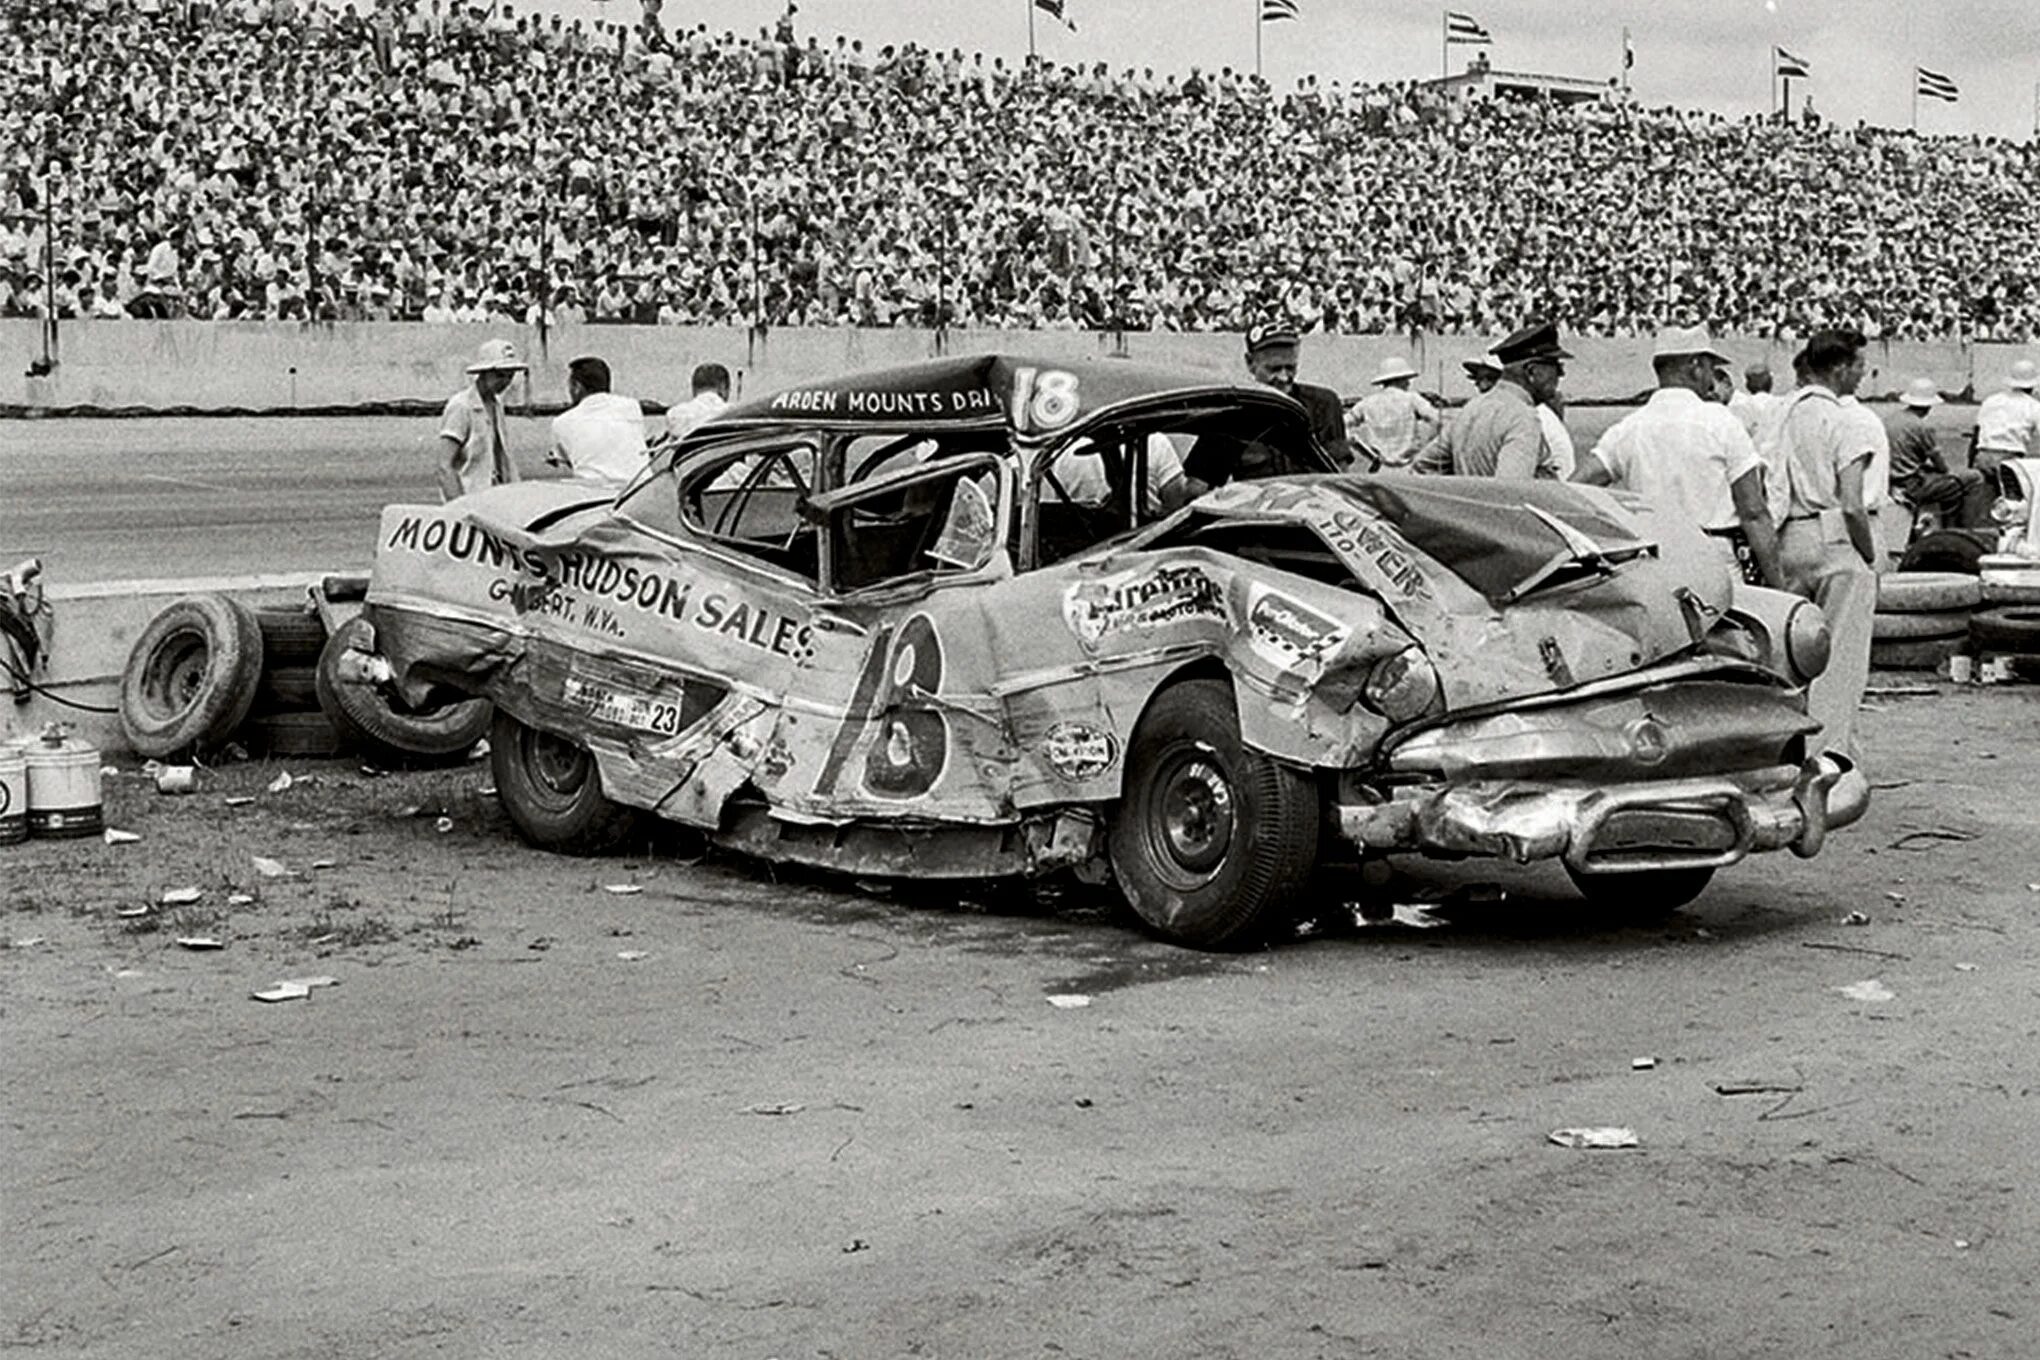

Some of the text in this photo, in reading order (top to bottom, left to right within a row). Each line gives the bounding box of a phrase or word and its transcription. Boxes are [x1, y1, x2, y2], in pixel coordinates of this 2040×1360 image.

[771, 391, 837, 411] ARDEN
[848, 392, 943, 413] MOUNTS
[1012, 367, 1080, 431] 18
[389, 518, 549, 578] MOUNTS
[558, 552, 692, 621] HUDSON
[651, 704, 678, 733] 23
[812, 611, 949, 801] 18
